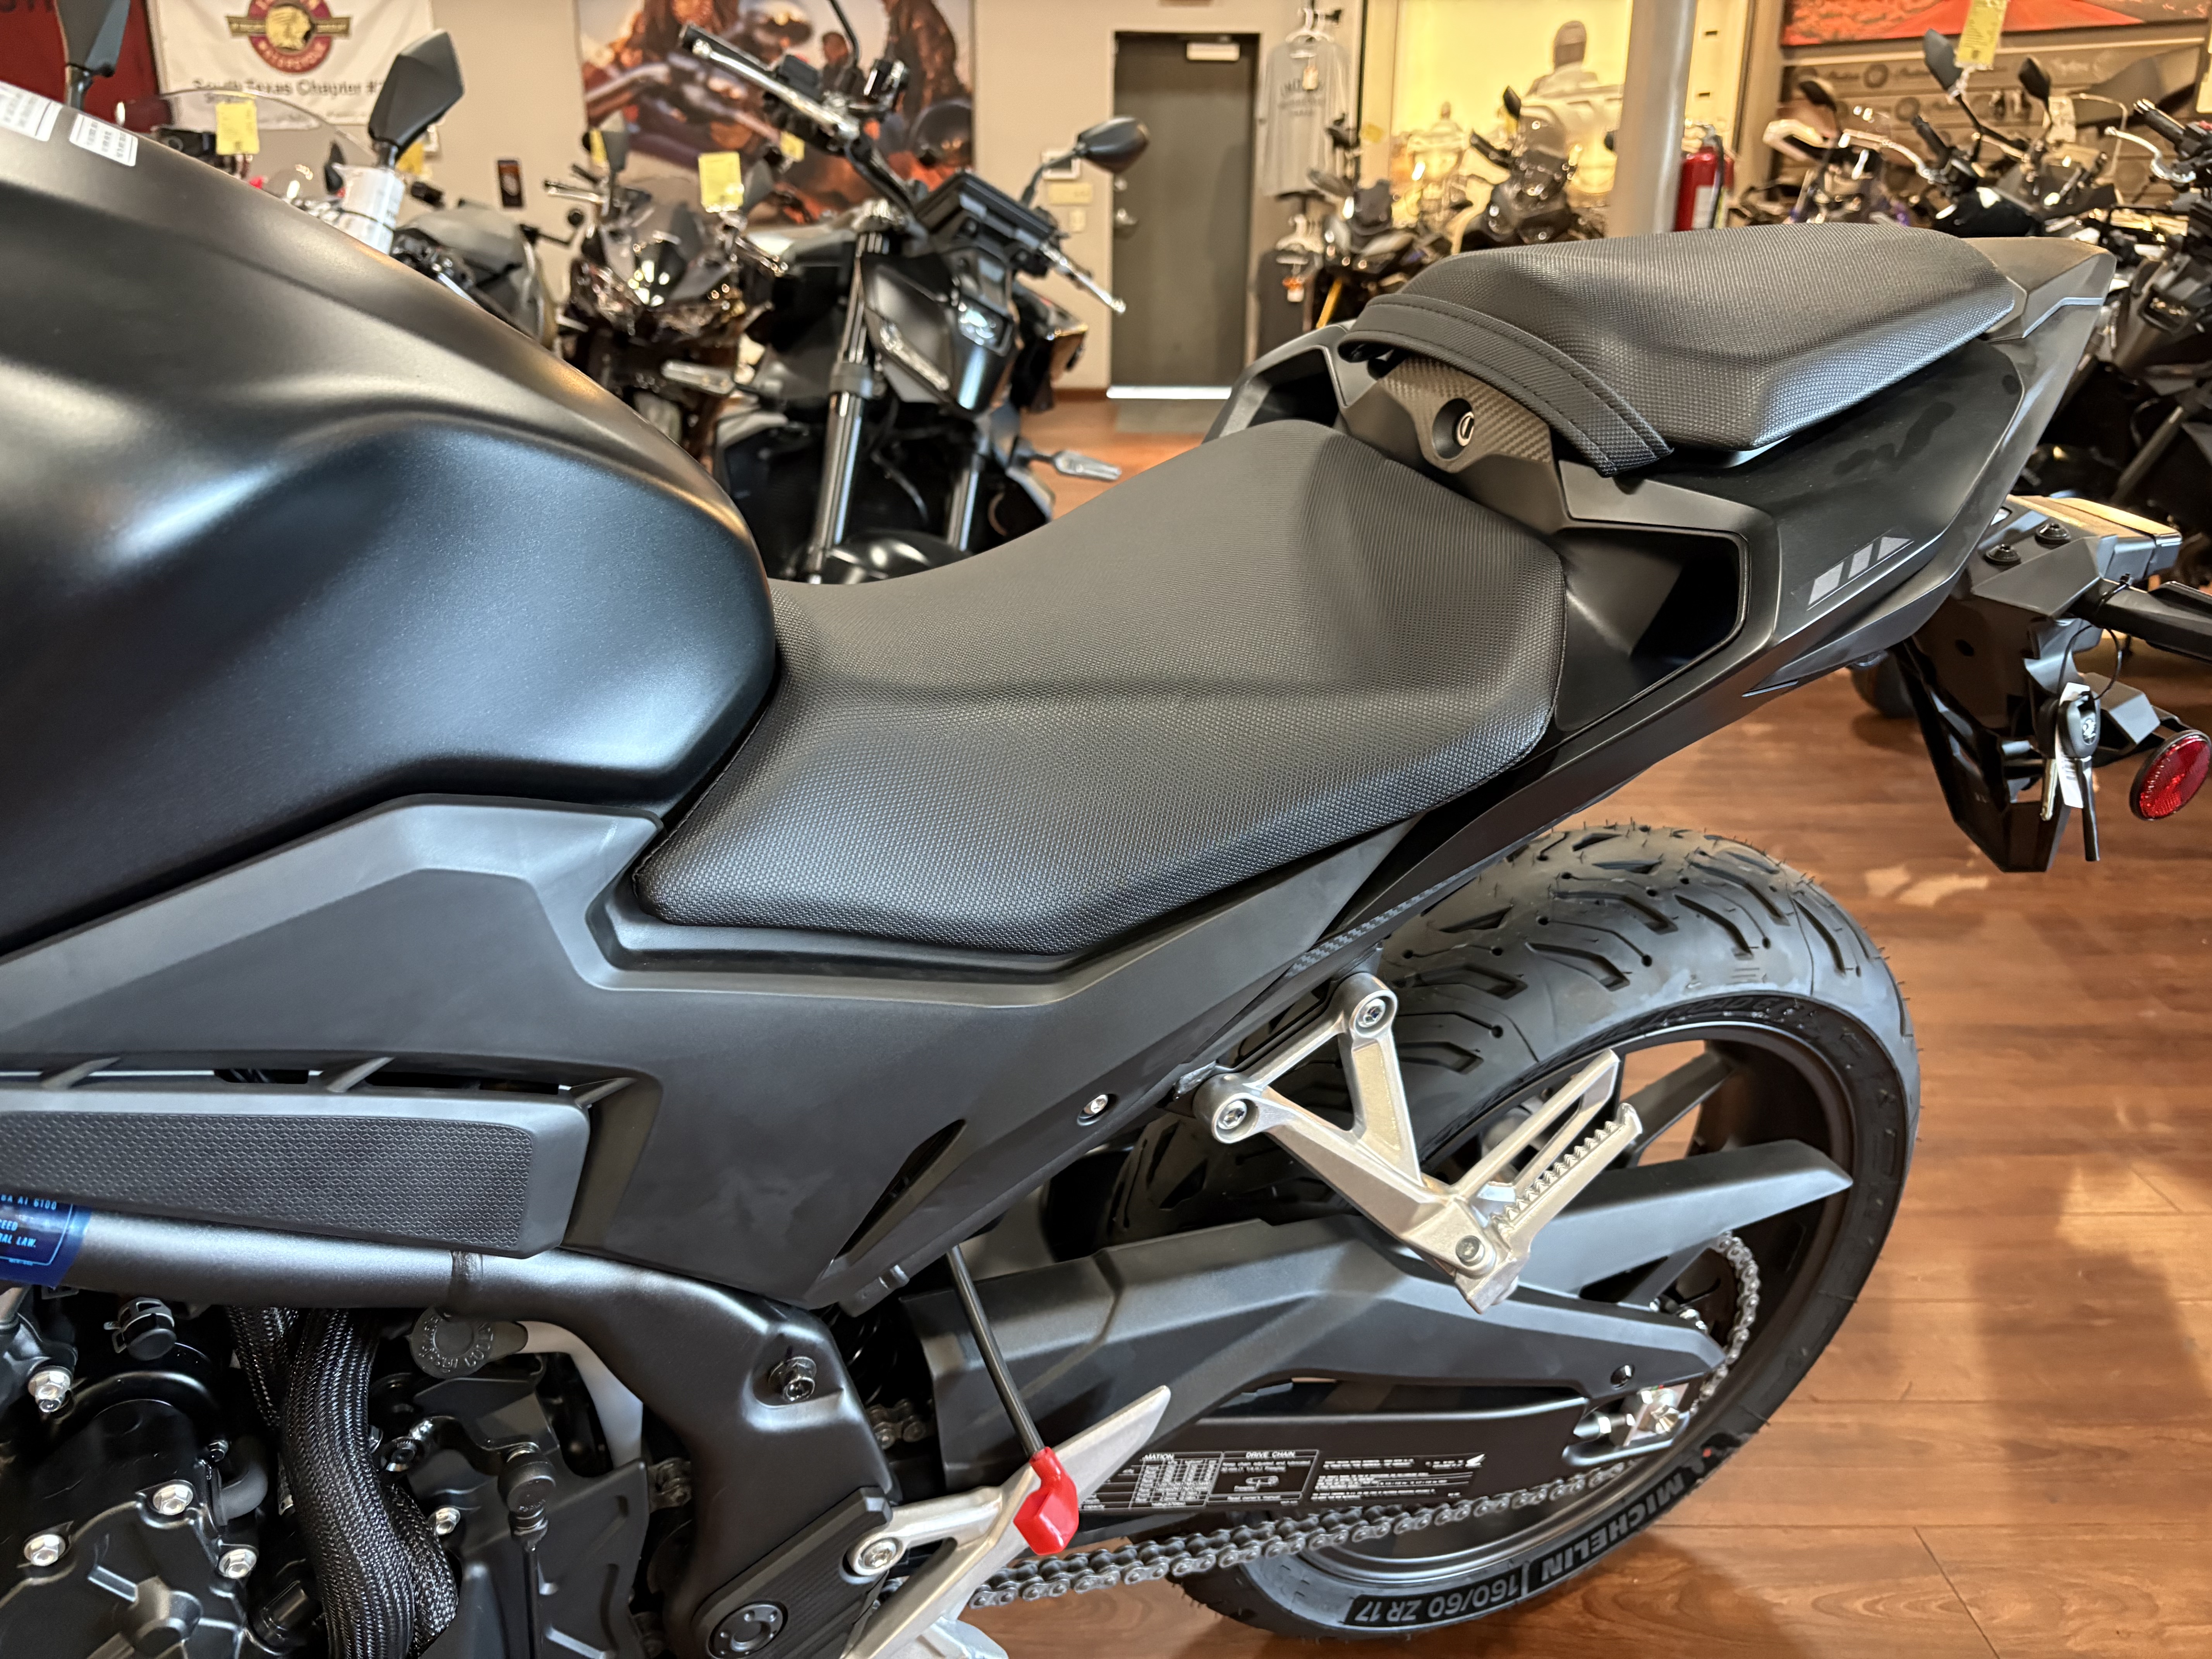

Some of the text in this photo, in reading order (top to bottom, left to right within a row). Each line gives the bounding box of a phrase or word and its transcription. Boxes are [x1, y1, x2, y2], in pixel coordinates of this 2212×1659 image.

[295, 79, 362, 99] Chapter
[34, 1198, 57, 1210] 6100
[16, 1236, 36, 1247] LAW.
[1541, 1473, 1685, 1582] MICHELIN
[1354, 1574, 1520, 1622] 160/60 ZR 17
